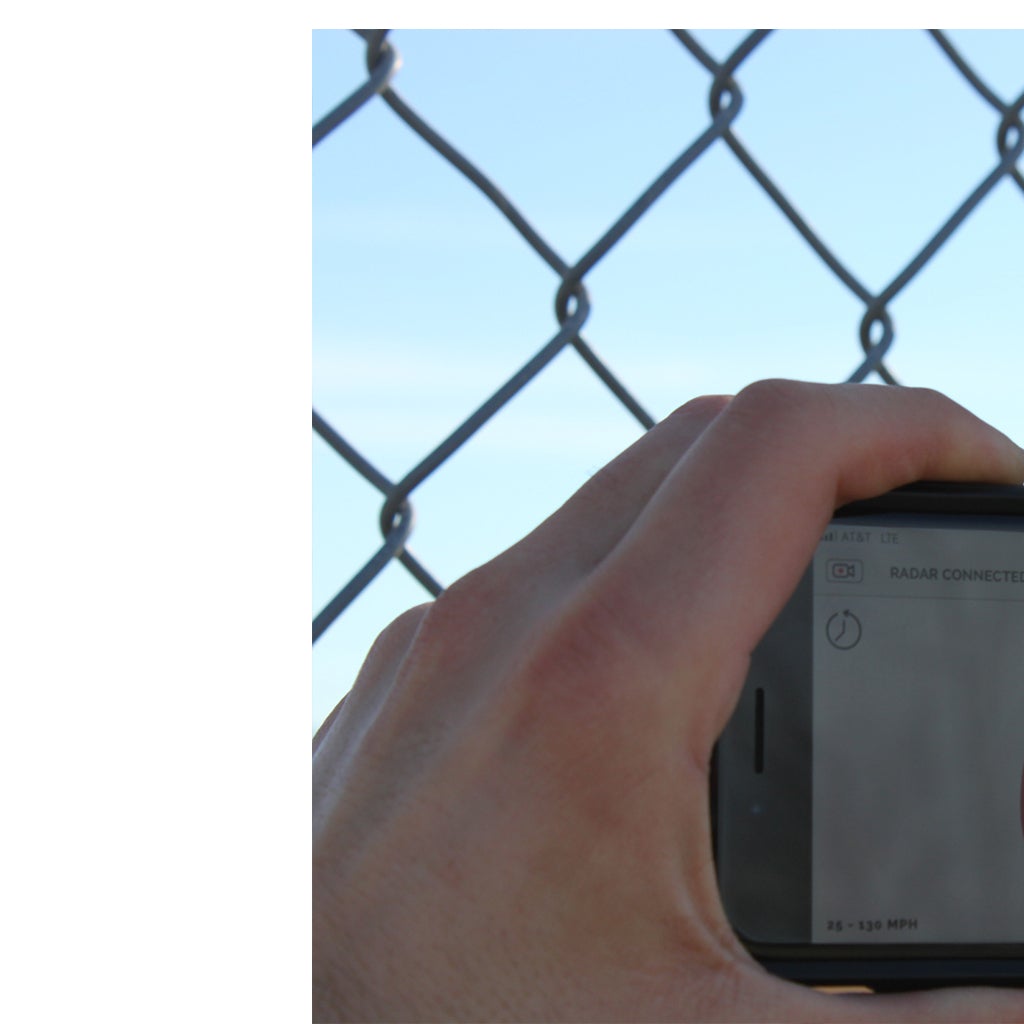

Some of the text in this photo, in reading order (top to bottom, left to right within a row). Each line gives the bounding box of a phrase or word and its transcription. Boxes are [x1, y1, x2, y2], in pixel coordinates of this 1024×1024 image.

[841, 530, 899, 545] AT&T LTE
[890, 566, 938, 581] RADAR
[887, 918, 918, 931] MPH
